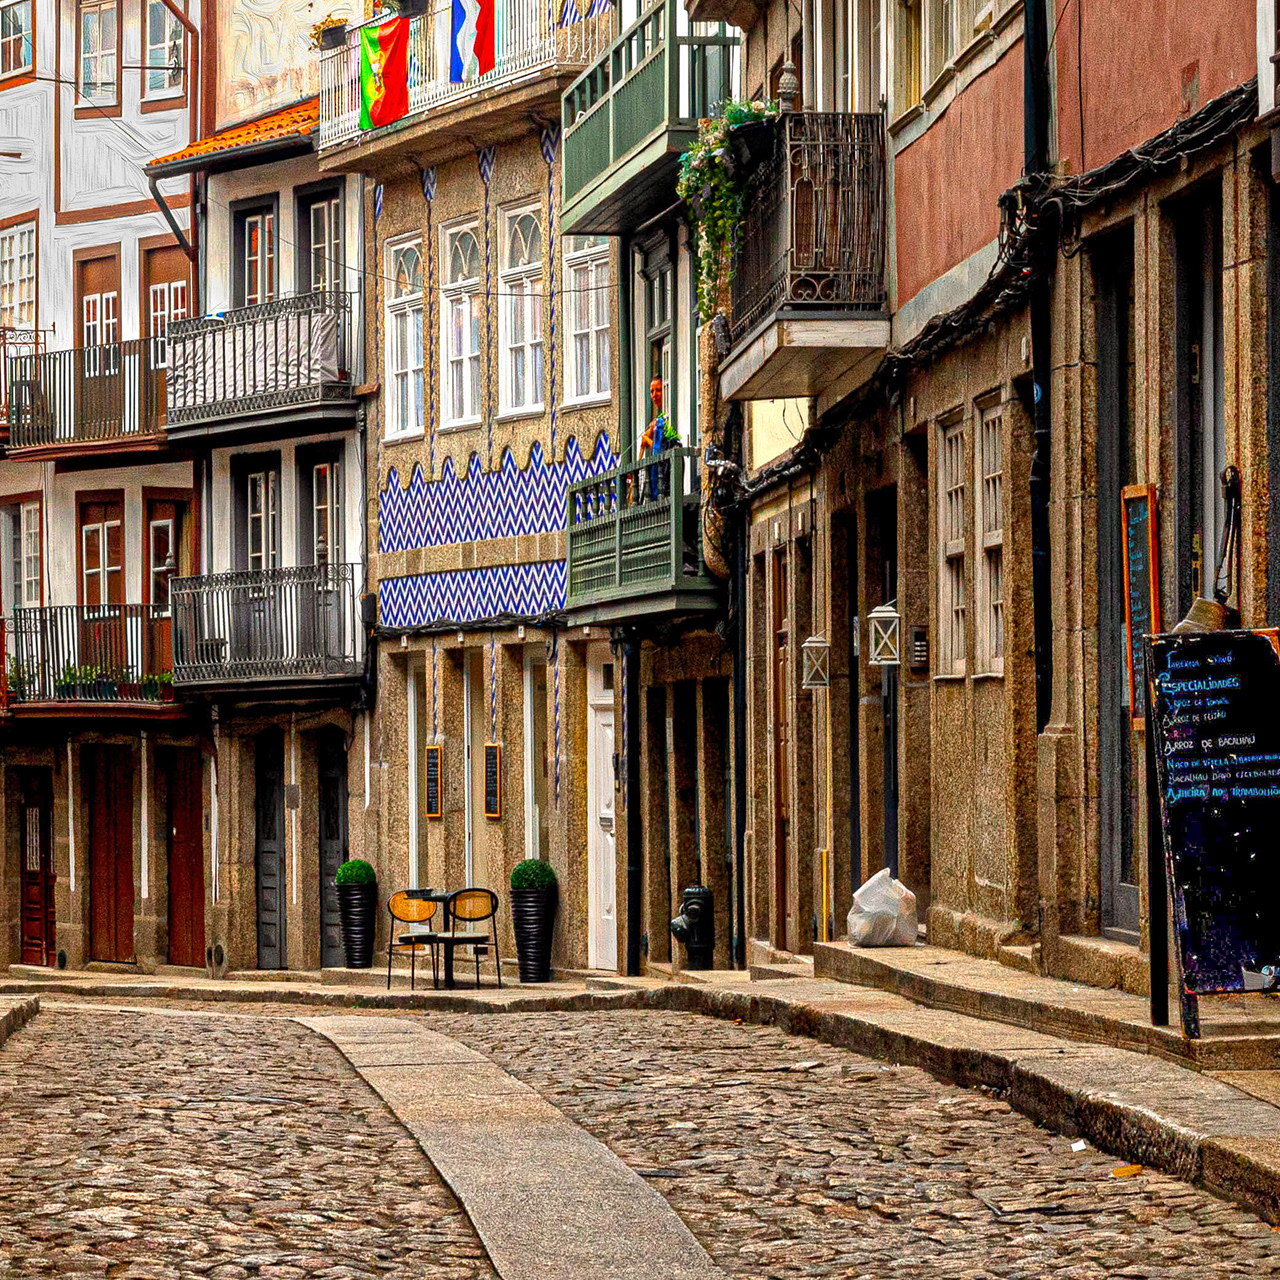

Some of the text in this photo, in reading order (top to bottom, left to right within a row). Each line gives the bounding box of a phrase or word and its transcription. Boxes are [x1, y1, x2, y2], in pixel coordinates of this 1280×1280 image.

[1159, 672, 1240, 696] ESPECIALIDADES
[1164, 735, 1256, 756] ARROZ DE BACALHAU
[1168, 772, 1208, 784] BACALHAU
